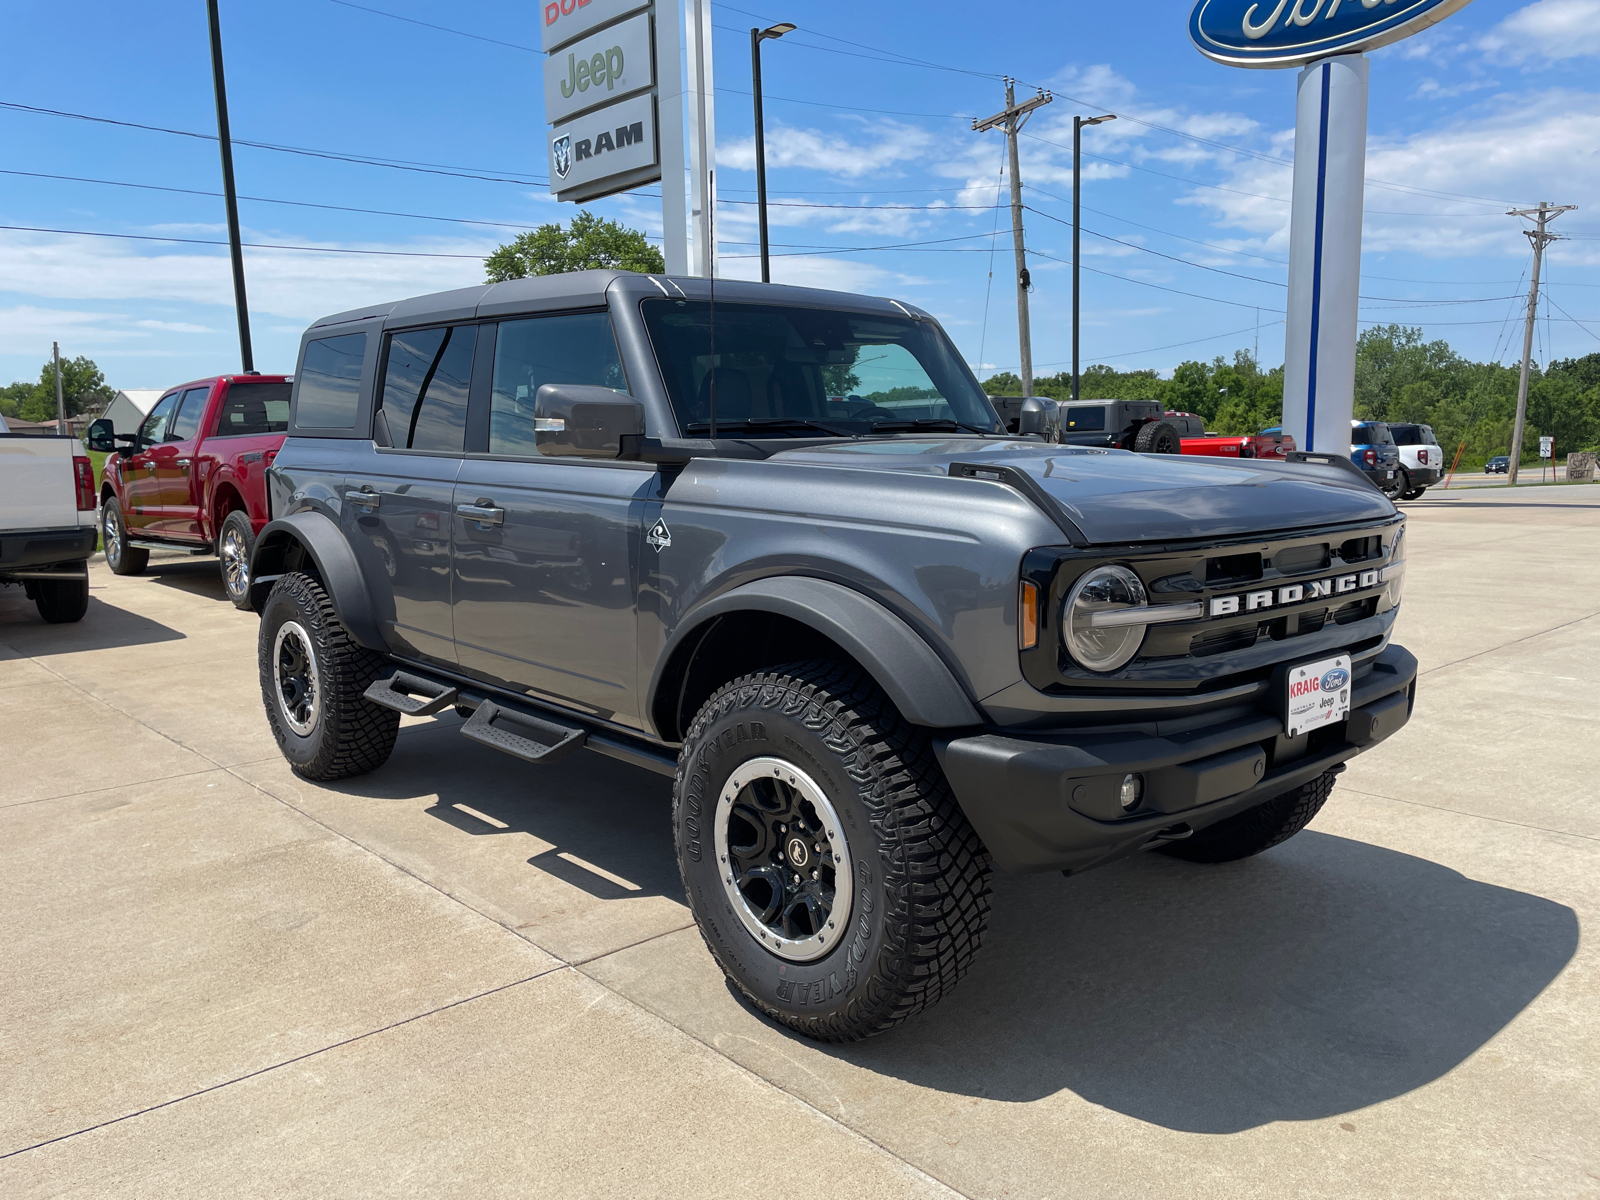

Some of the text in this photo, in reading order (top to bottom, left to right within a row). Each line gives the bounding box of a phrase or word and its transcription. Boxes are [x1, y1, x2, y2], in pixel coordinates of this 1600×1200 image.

[560, 45, 624, 99] Jeep
[574, 121, 644, 163] RAM
[1210, 570, 1378, 616] BRONCO
[1290, 672, 1344, 699] KRAIG Ford
[1319, 697, 1334, 709] Jeep
